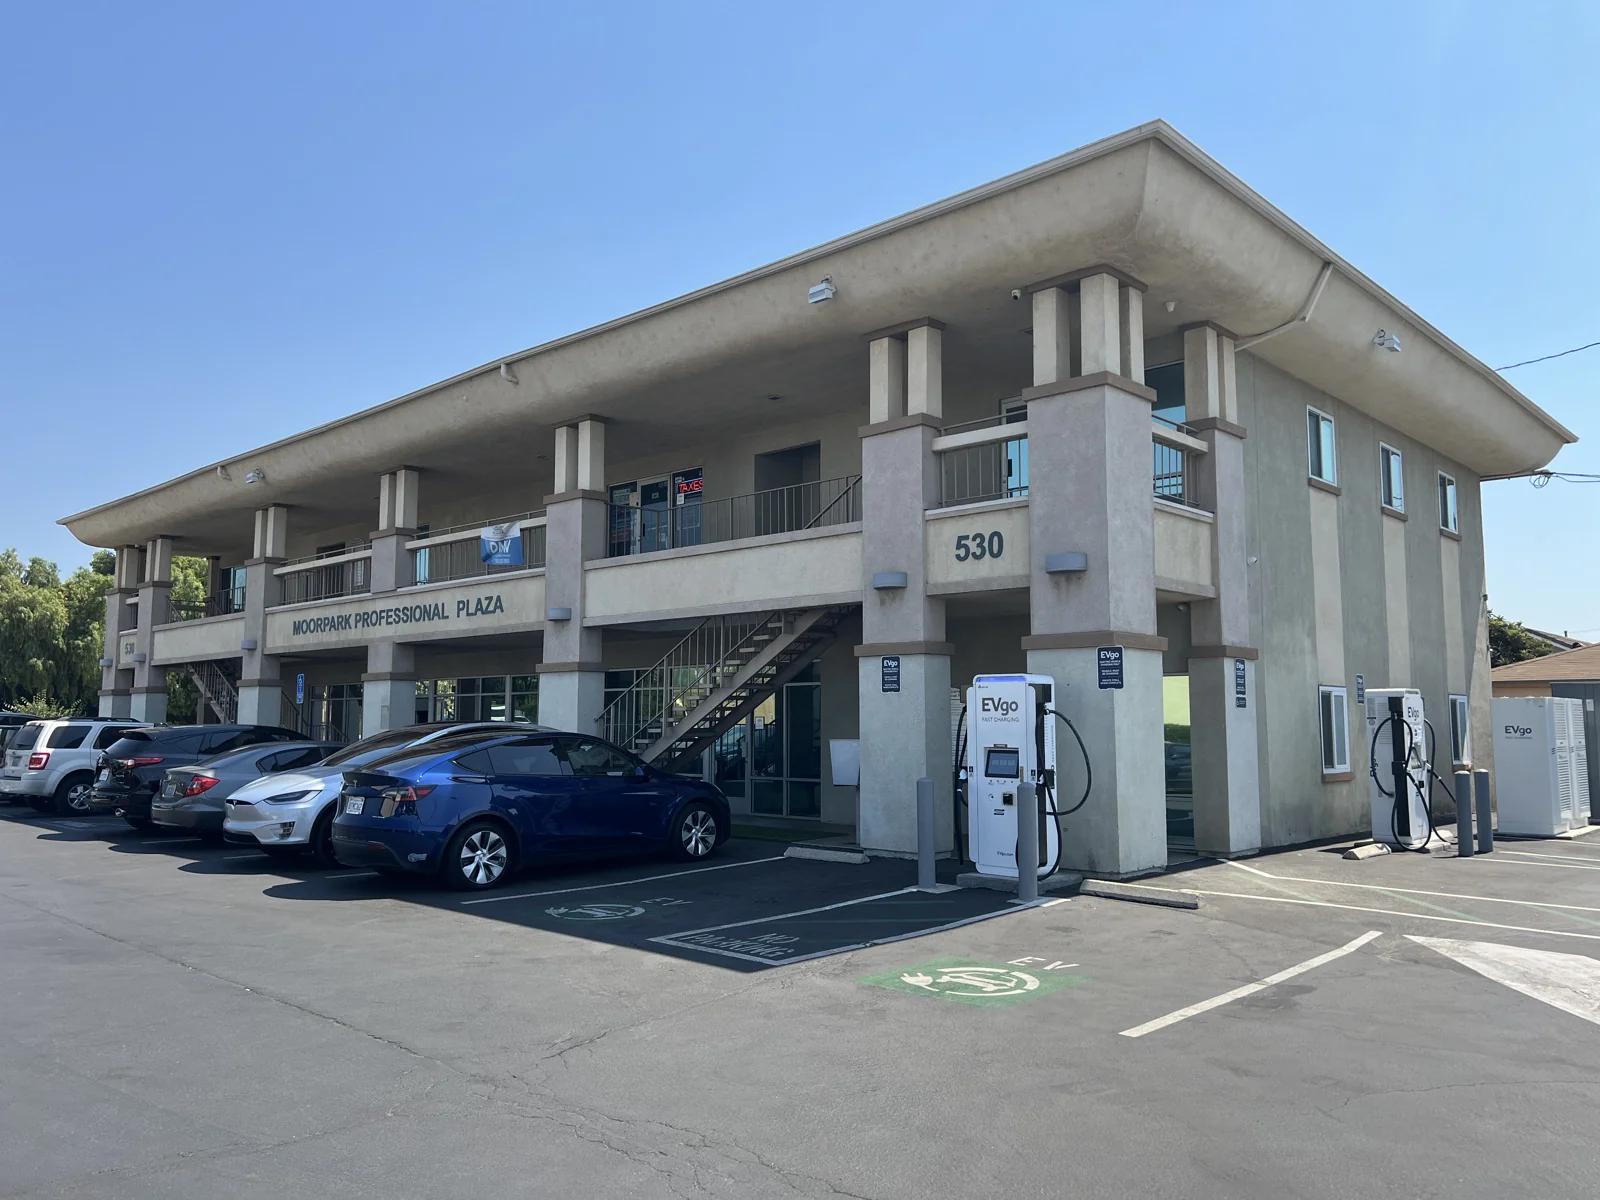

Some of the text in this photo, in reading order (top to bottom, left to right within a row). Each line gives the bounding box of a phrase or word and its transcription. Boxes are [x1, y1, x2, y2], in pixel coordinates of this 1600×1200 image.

[679, 480, 704, 494] TAXES
[955, 531, 1004, 562] 530
[292, 594, 504, 636] MOORPARK PROFESSIONAL PLAZA
[1100, 651, 1120, 660] EVgo
[982, 697, 1019, 716] EVgo
[1407, 707, 1420, 721] EVgo
[1504, 725, 1532, 736] EVgo
[1006, 956, 1081, 970] EV
